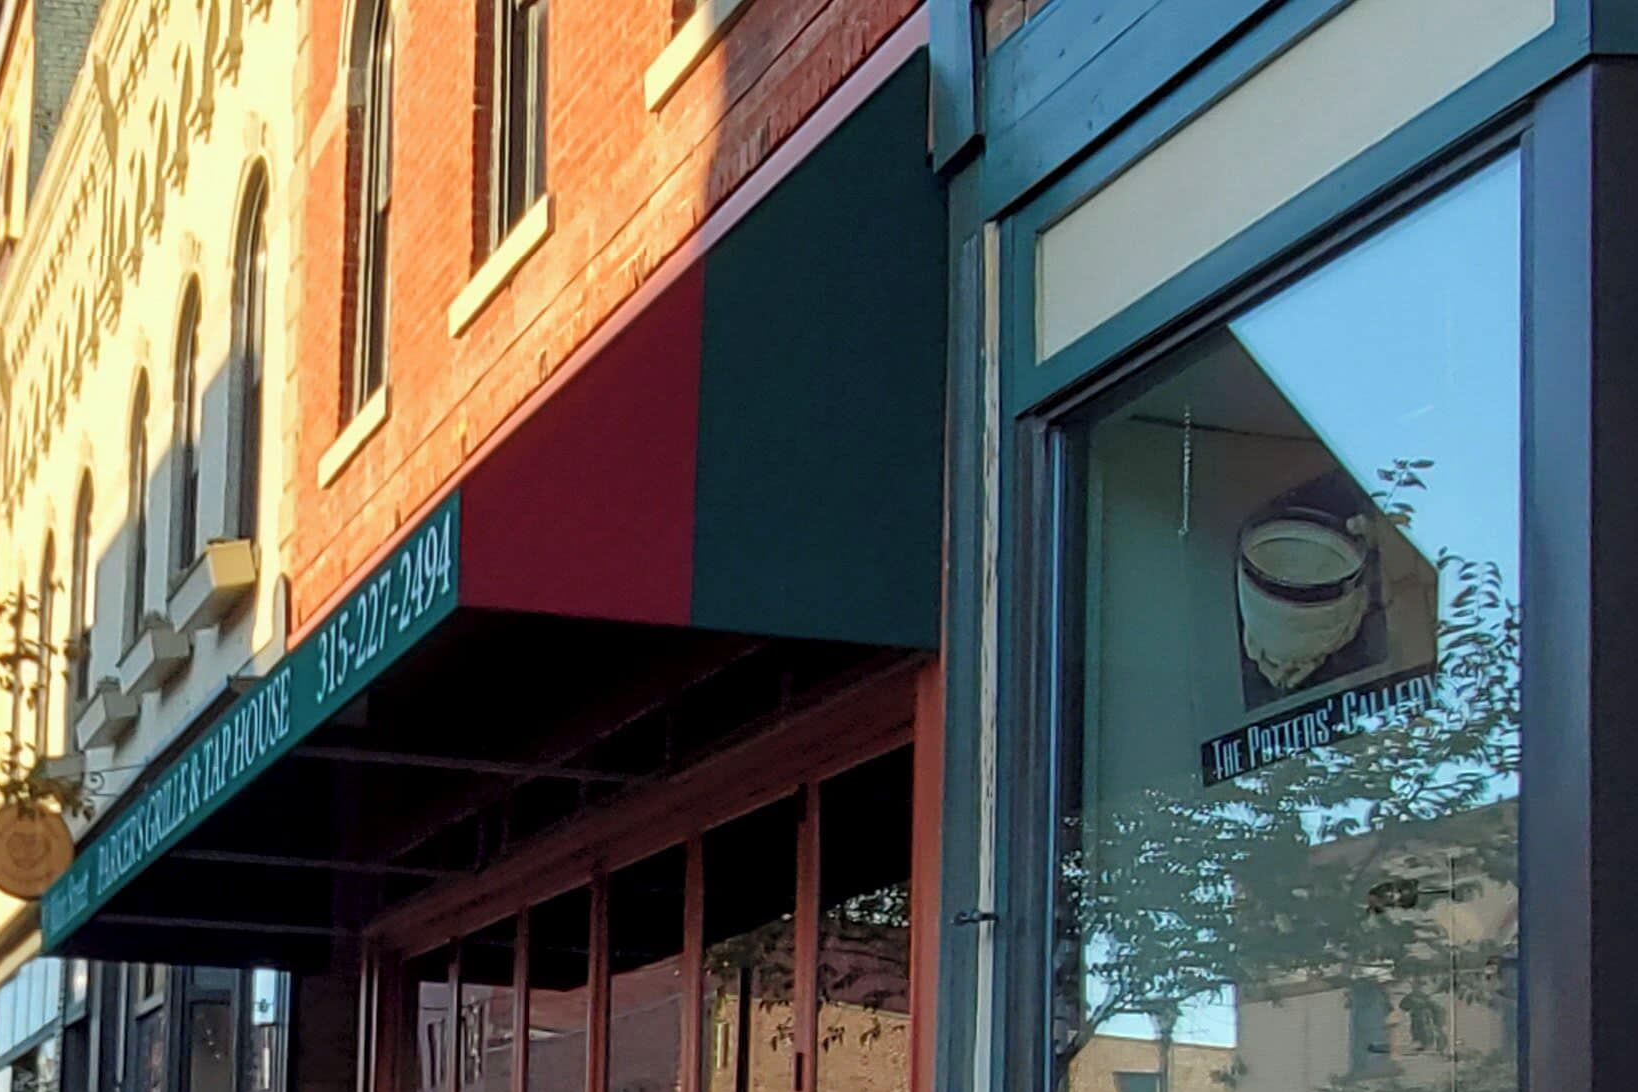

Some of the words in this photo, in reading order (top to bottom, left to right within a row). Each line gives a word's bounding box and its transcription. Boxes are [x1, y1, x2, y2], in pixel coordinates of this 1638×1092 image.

[145, 760, 188, 851] GRILLE
[188, 752, 202, 813] &
[203, 723, 232, 801] TAP
[231, 667, 292, 776] HOUSE
[317, 511, 452, 704] 315-227-2494
[1213, 738, 1243, 781] THE
